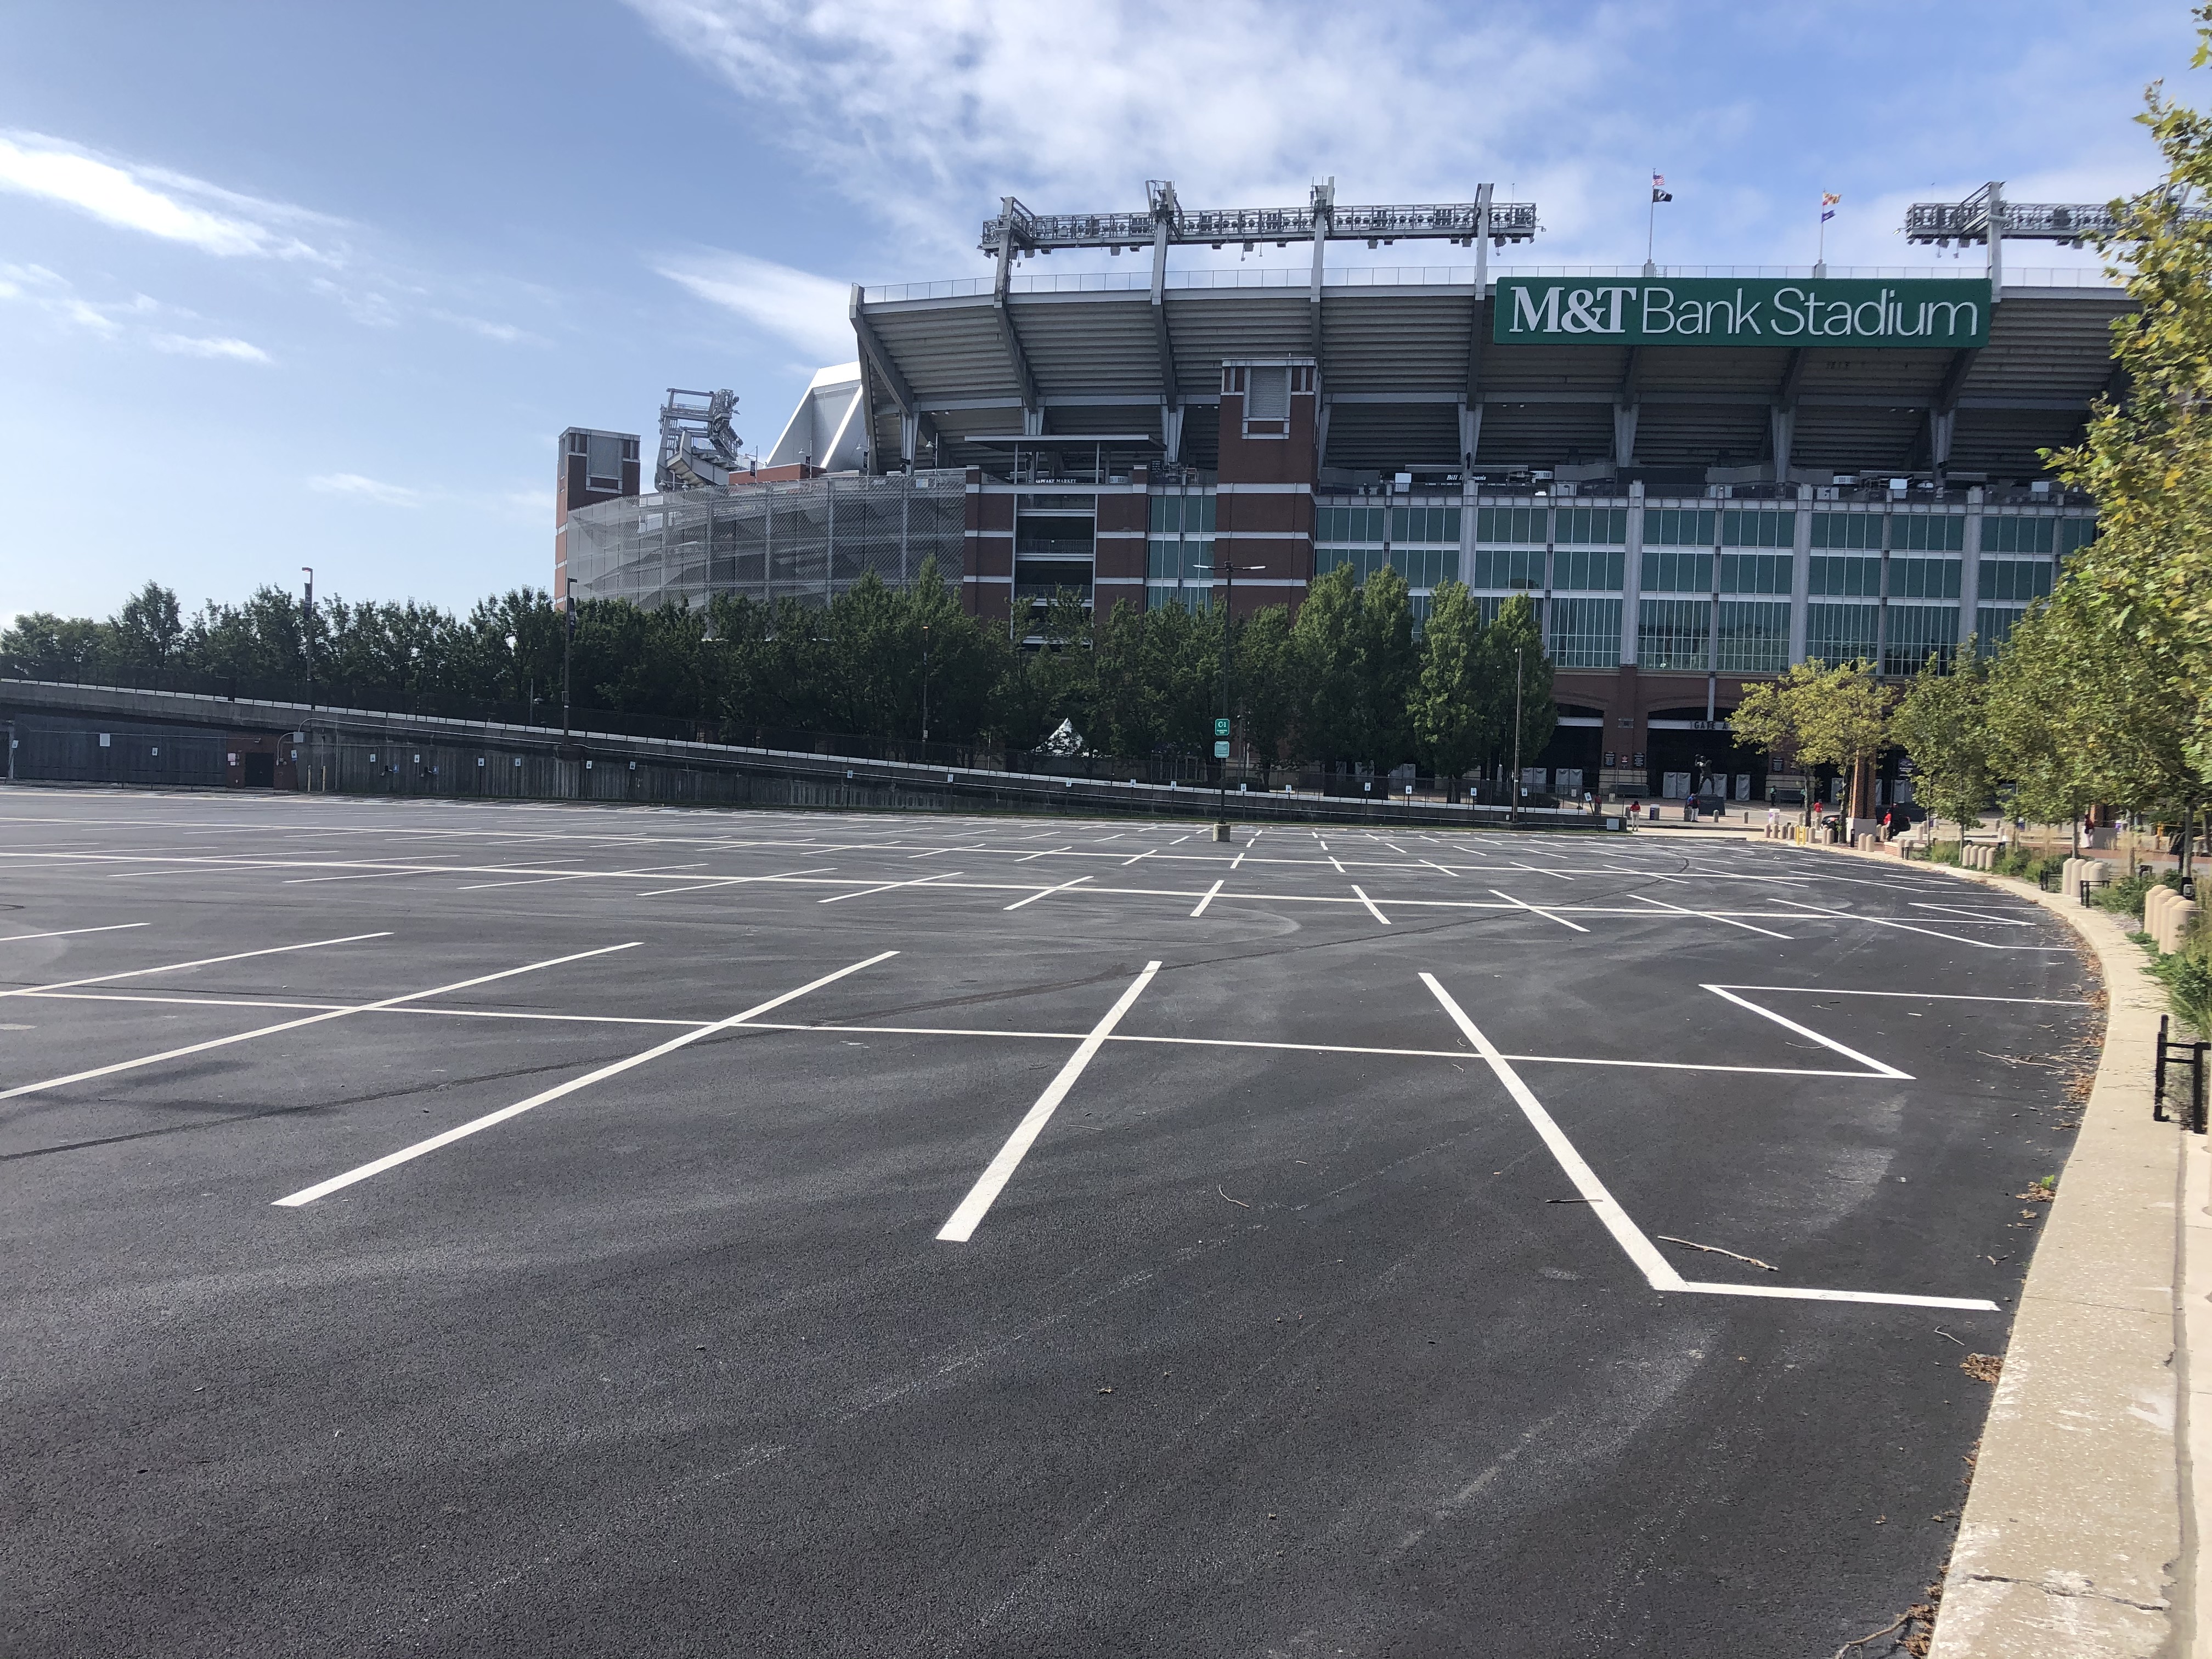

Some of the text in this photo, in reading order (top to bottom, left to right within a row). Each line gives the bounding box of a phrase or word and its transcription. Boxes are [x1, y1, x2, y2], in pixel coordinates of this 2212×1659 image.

[1509, 286, 1978, 336] M&T Bank Stadium
